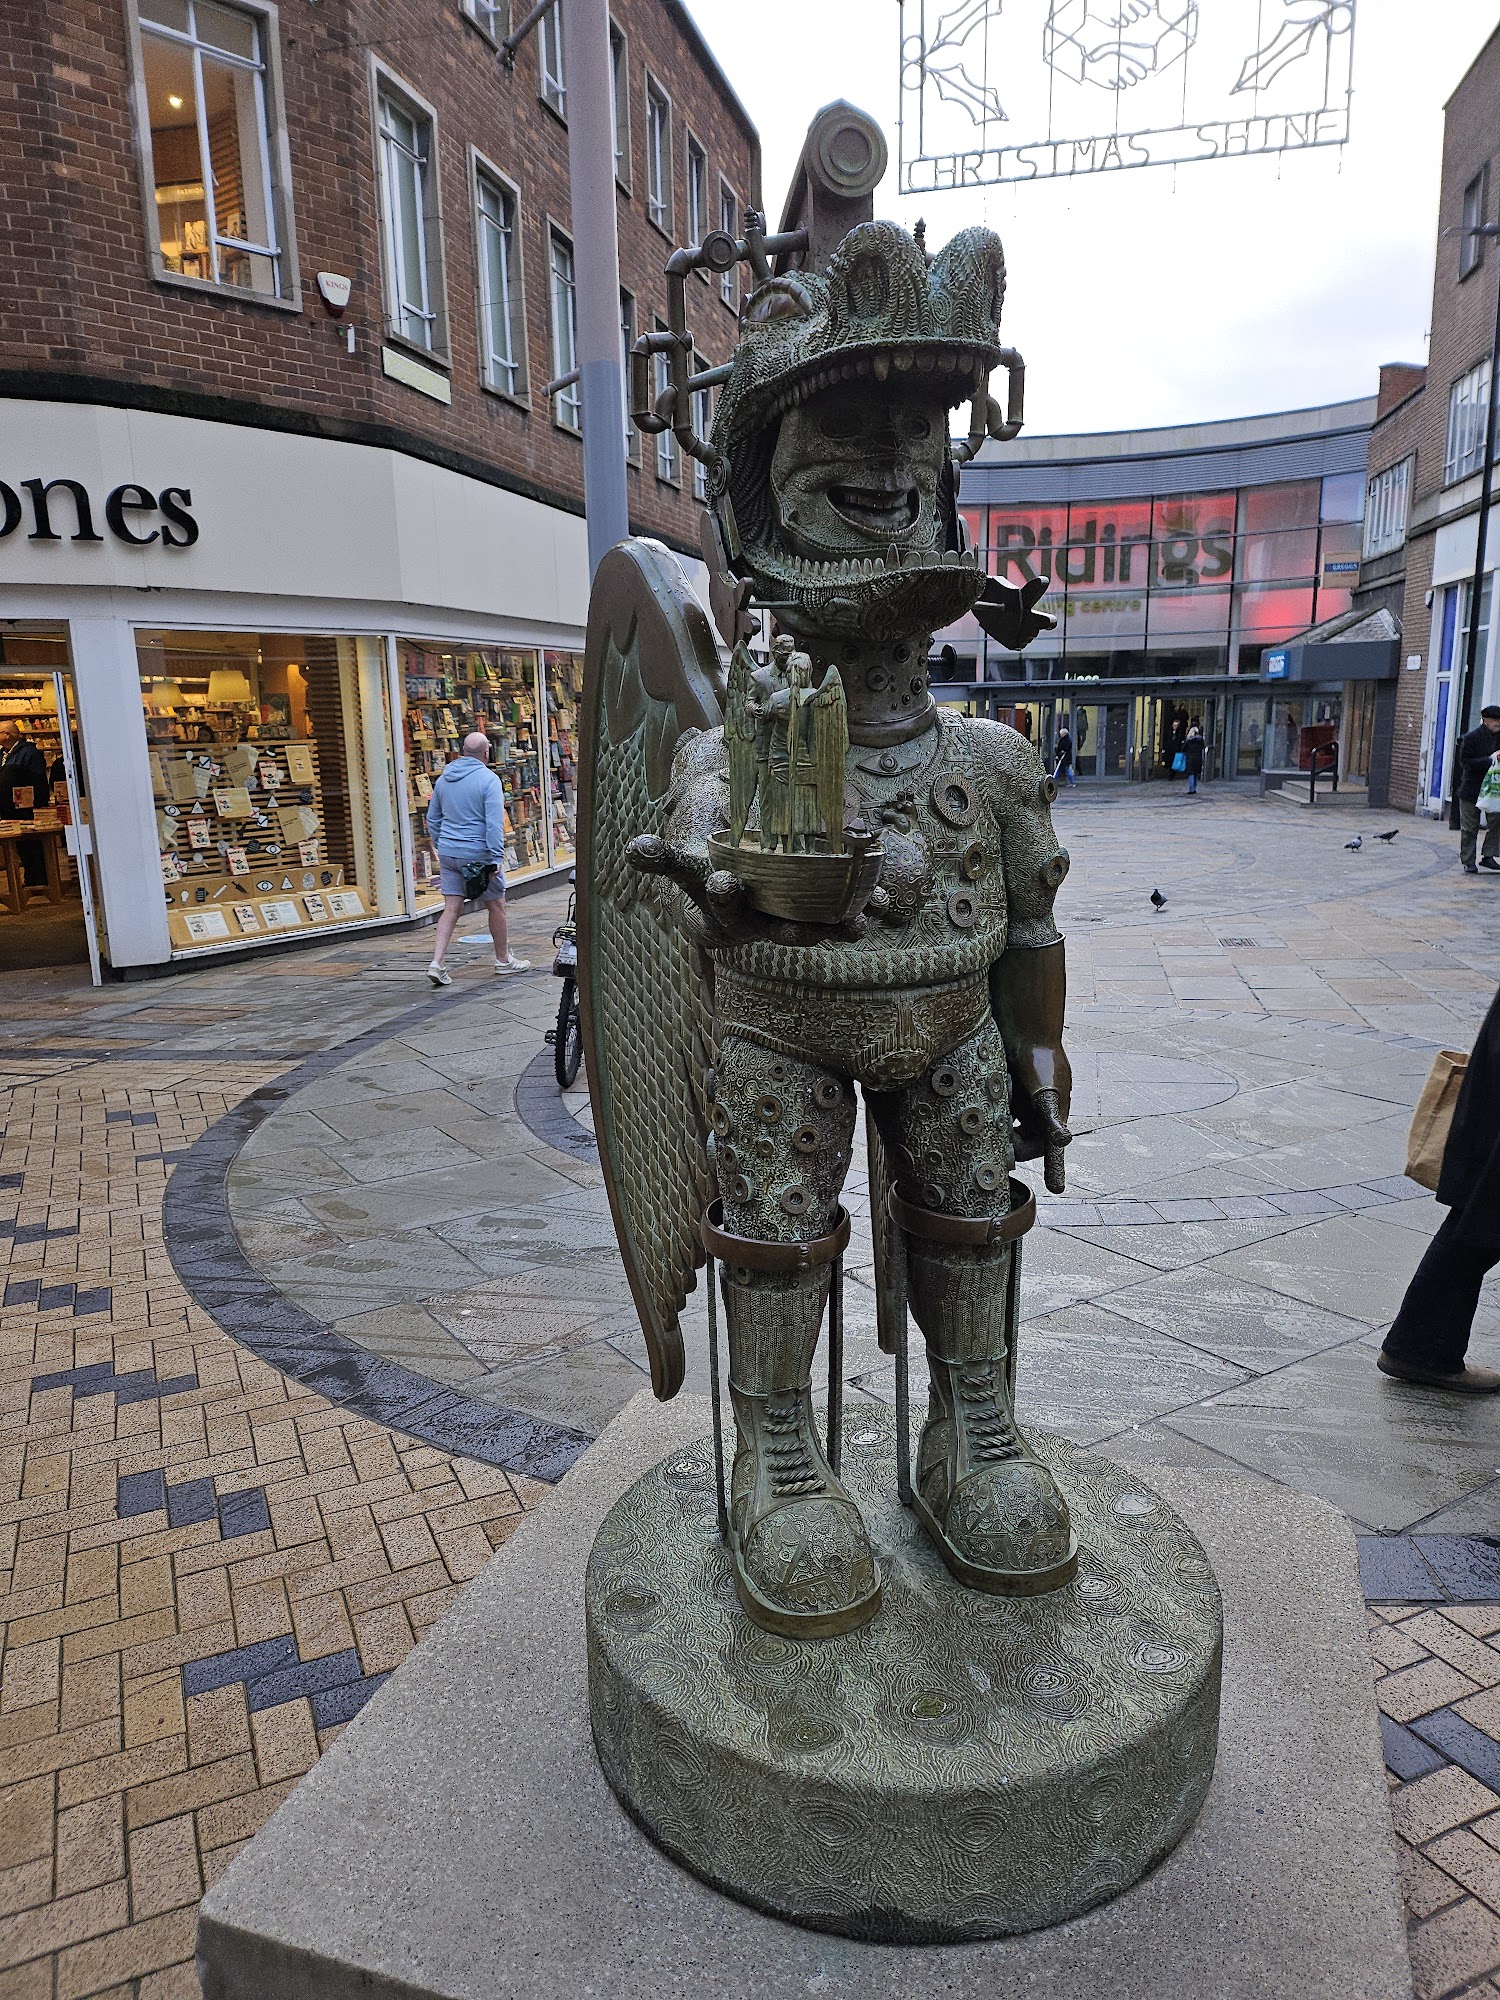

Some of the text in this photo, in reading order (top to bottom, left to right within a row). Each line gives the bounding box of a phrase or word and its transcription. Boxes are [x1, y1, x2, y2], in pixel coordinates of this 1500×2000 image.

[907, 109, 1342, 190] CHRISTMAS SHINE
[325, 280, 349, 290] KINGS
[996, 517, 1233, 588] Ridings
